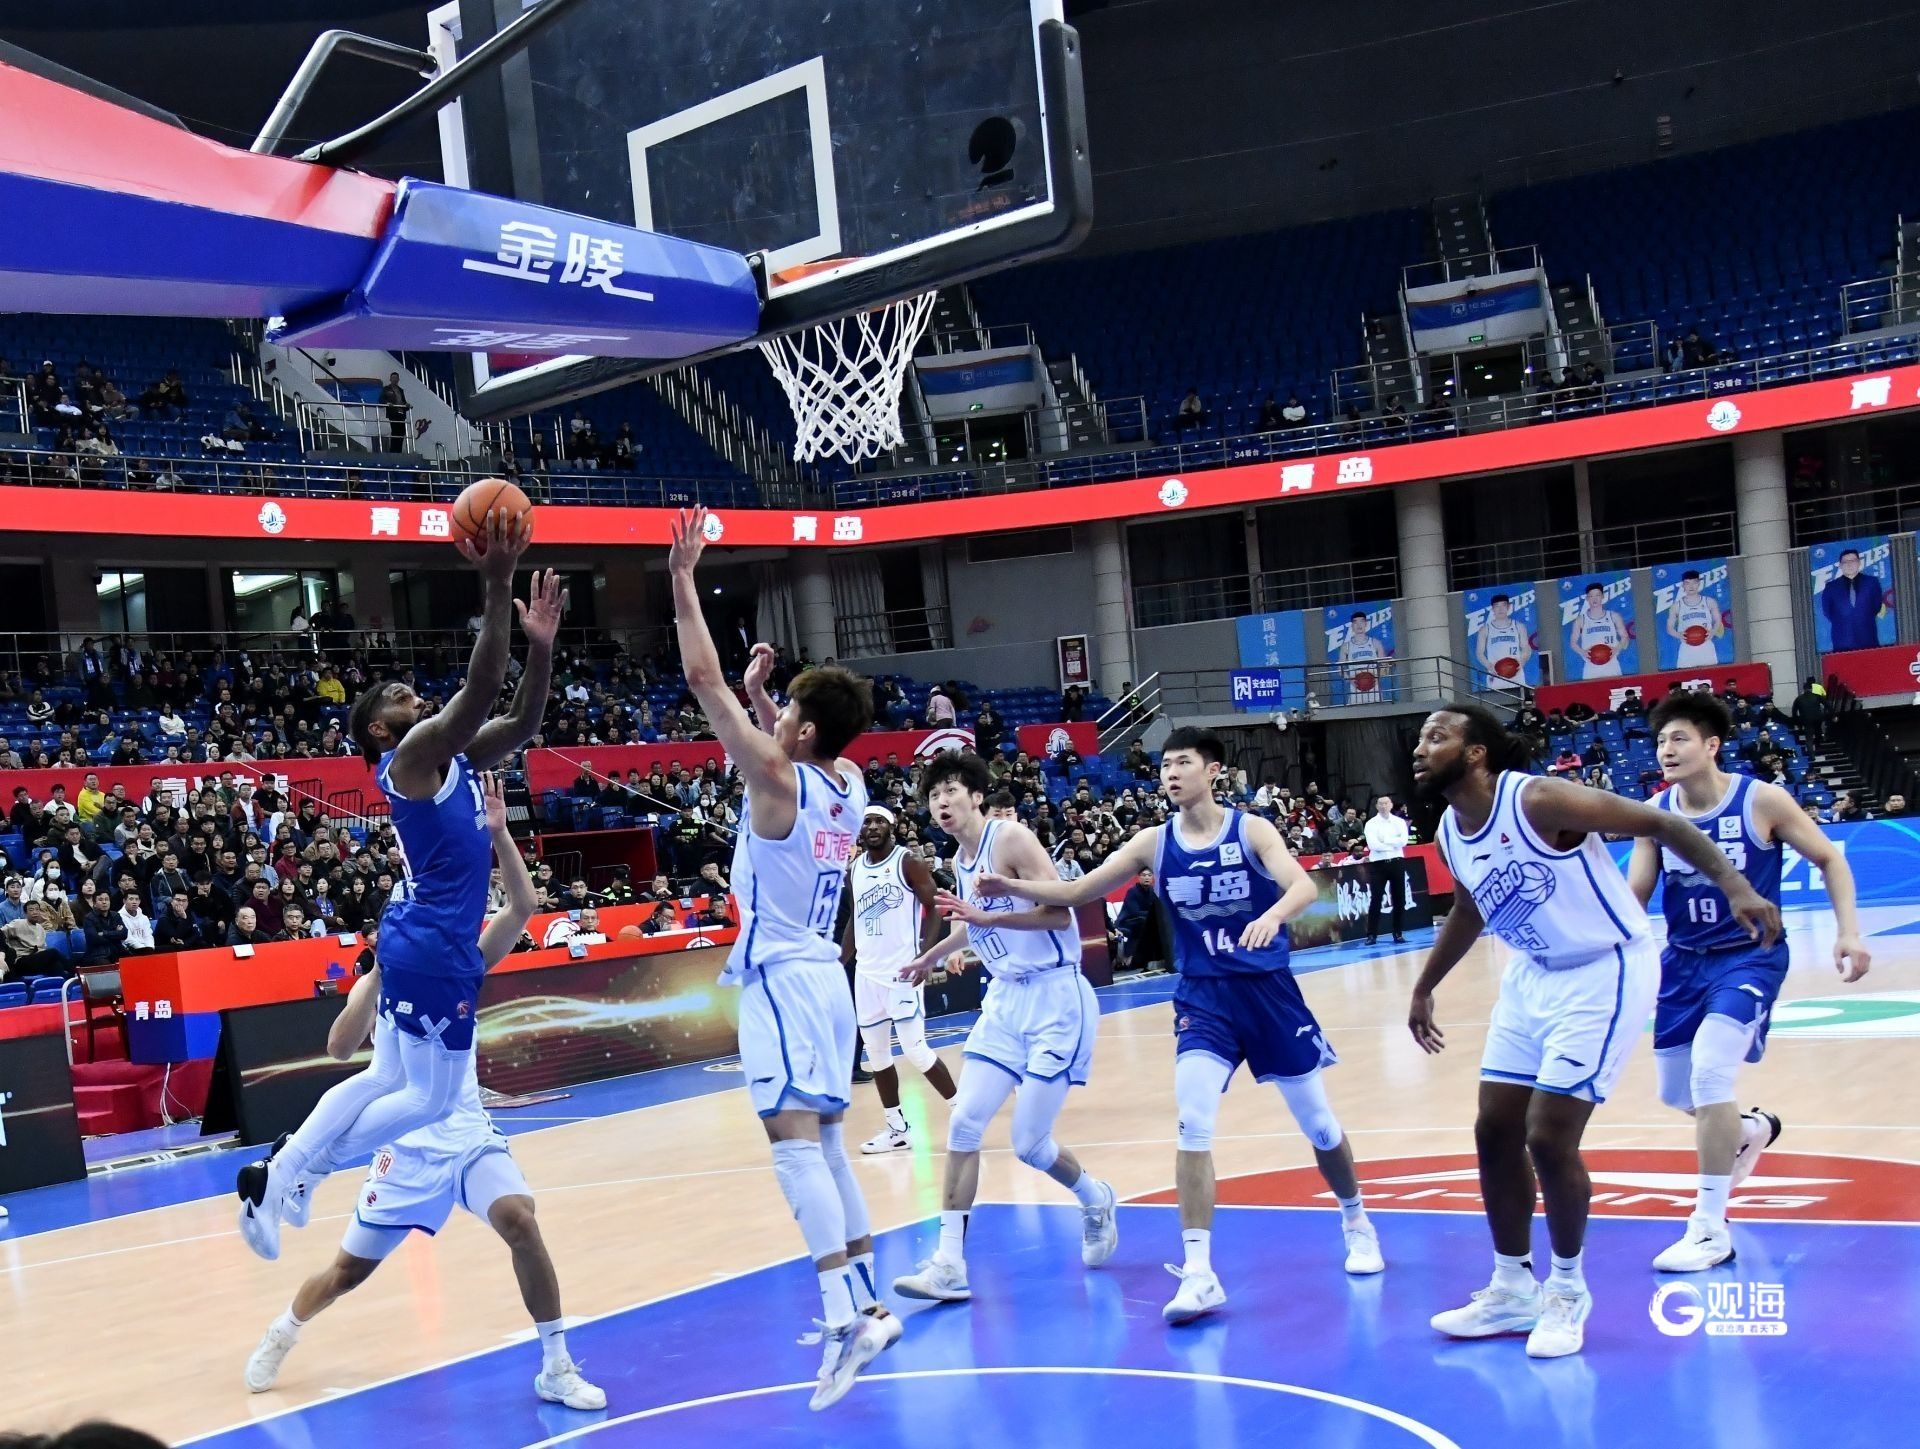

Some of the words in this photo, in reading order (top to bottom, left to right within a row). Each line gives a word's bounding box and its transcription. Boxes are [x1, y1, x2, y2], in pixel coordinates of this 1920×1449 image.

[462, 220, 654, 302] 金陵
[1712, 376, 1742, 390] 35看台
[1280, 457, 1373, 493] 青岛
[370, 506, 450, 537] 青岛
[792, 515, 863, 541] 青岛
[1252, 678, 1279, 689] 安全出口
[807, 870, 841, 931] 6
[857, 882, 891, 917] NINGBO
[1166, 870, 1250, 906] 青岛
[1477, 860, 1525, 922] INGBO
[1688, 898, 1717, 923] 19
[865, 917, 883, 936] 21
[1202, 928, 1235, 956] 14
[135, 1000, 172, 1020] 青岛
